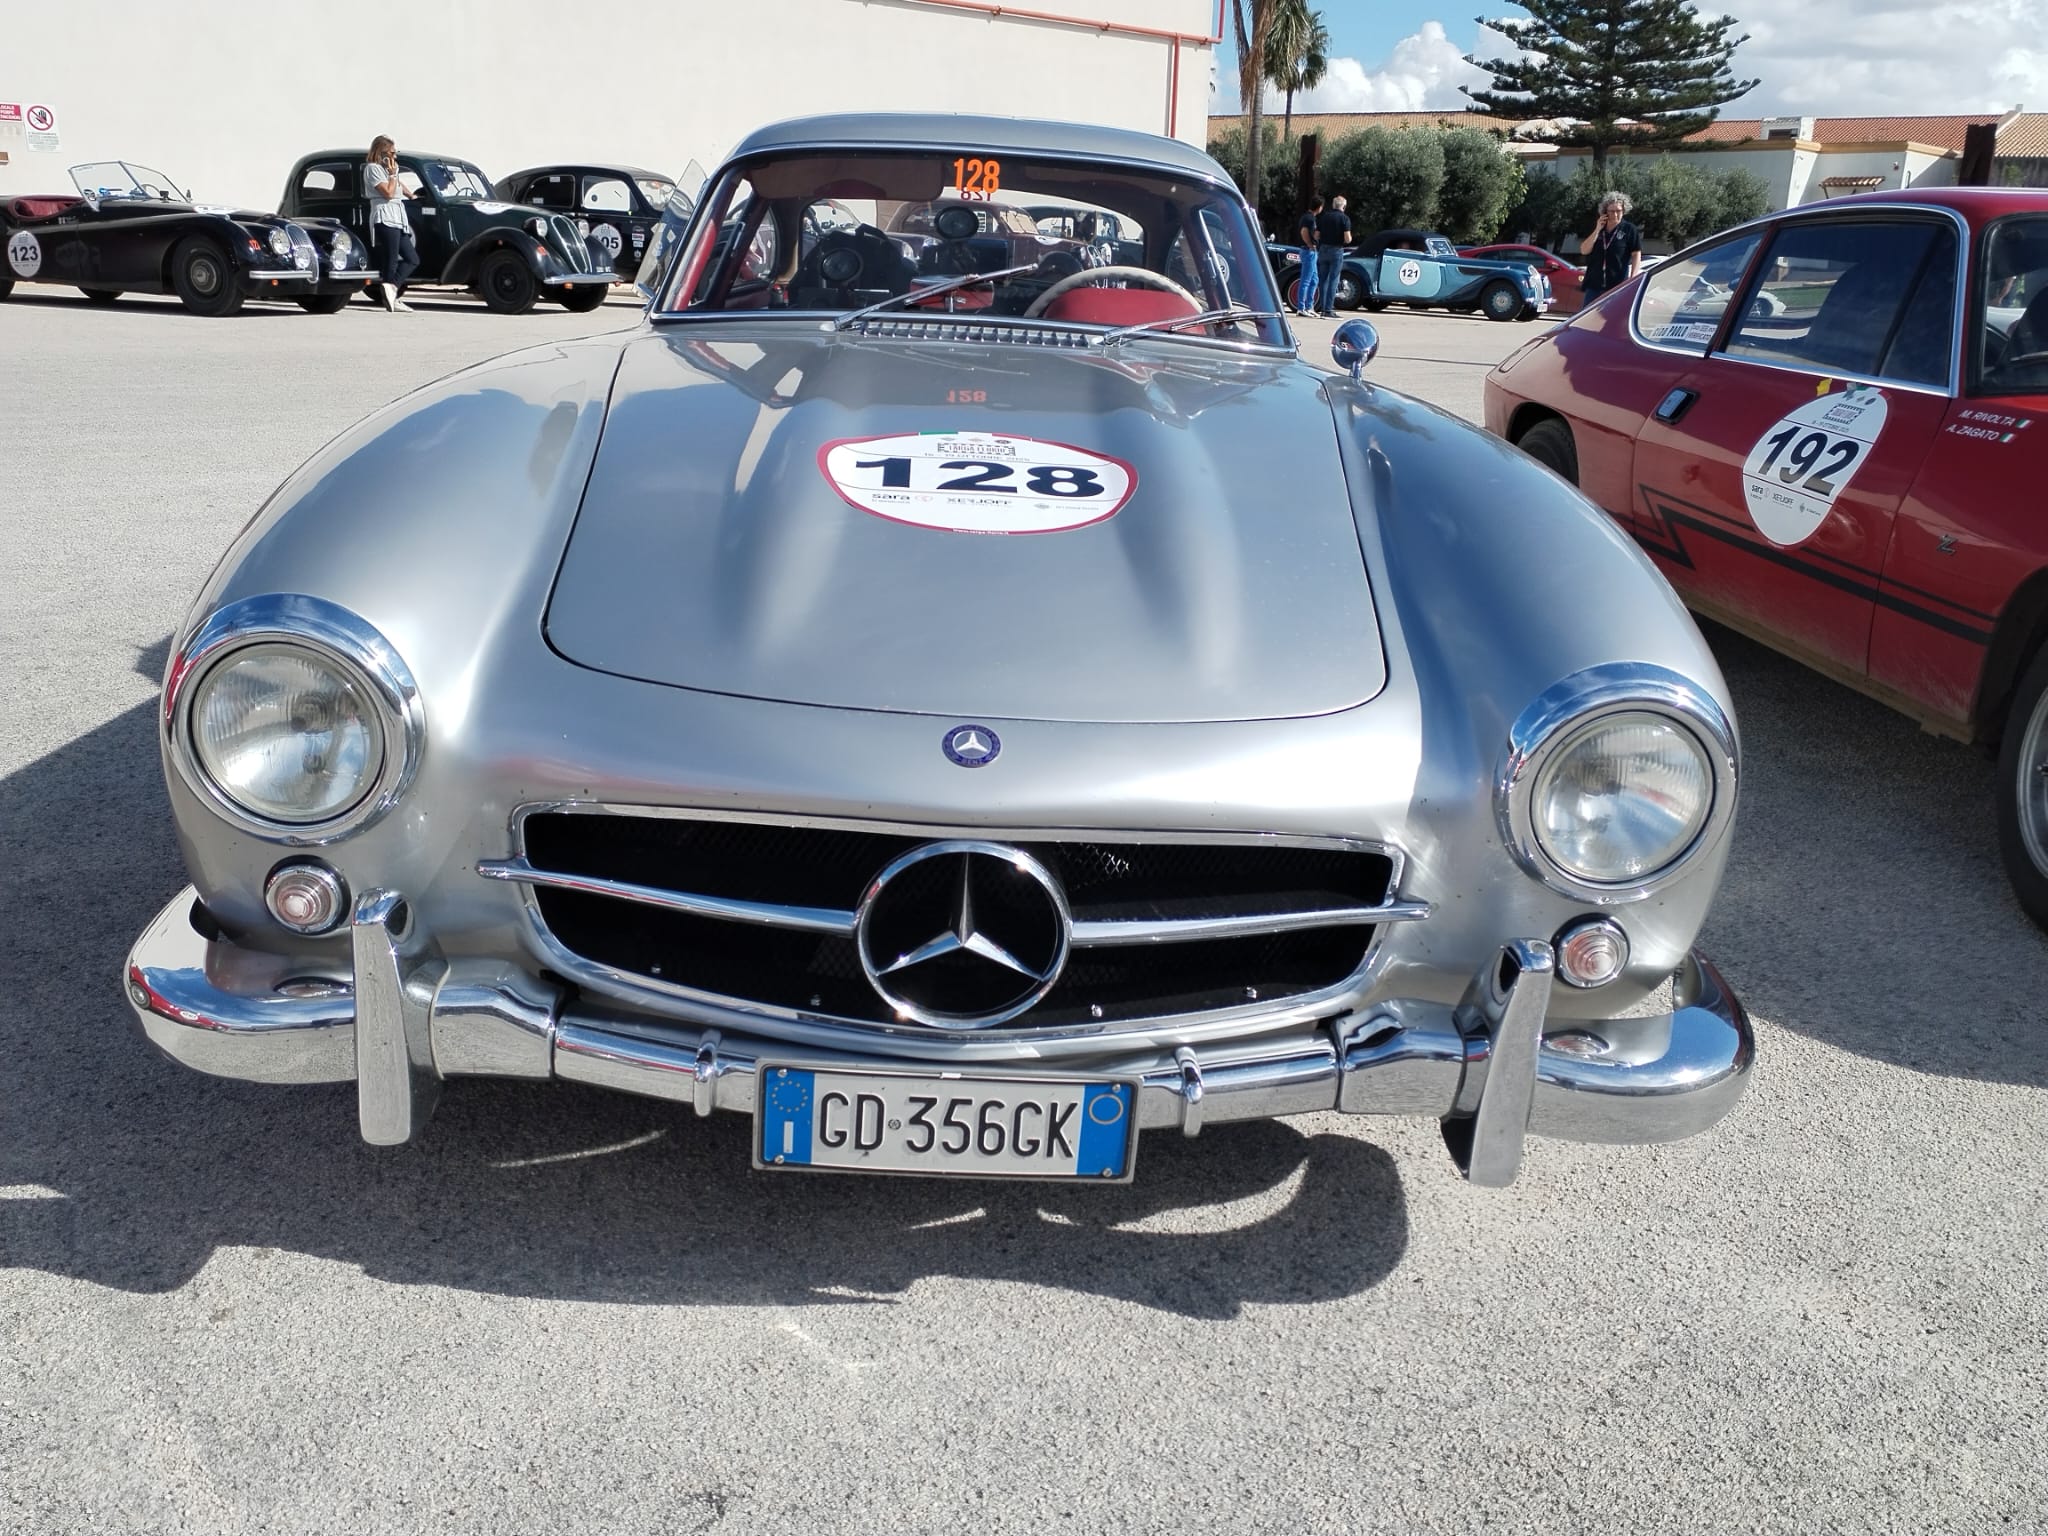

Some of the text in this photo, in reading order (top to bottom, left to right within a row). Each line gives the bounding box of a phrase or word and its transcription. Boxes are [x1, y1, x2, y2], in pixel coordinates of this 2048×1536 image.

[954, 158, 1000, 193] 128
[596, 235, 619, 249] 05
[11, 245, 38, 262] 123
[1401, 268, 1419, 278] 121
[1971, 411, 2016, 426] RIVOLTA
[1956, 425, 2000, 441] ZAGATO
[1757, 426, 1860, 497] 192
[855, 457, 1105, 497] 128
[819, 1092, 1079, 1158] GD 356GK
